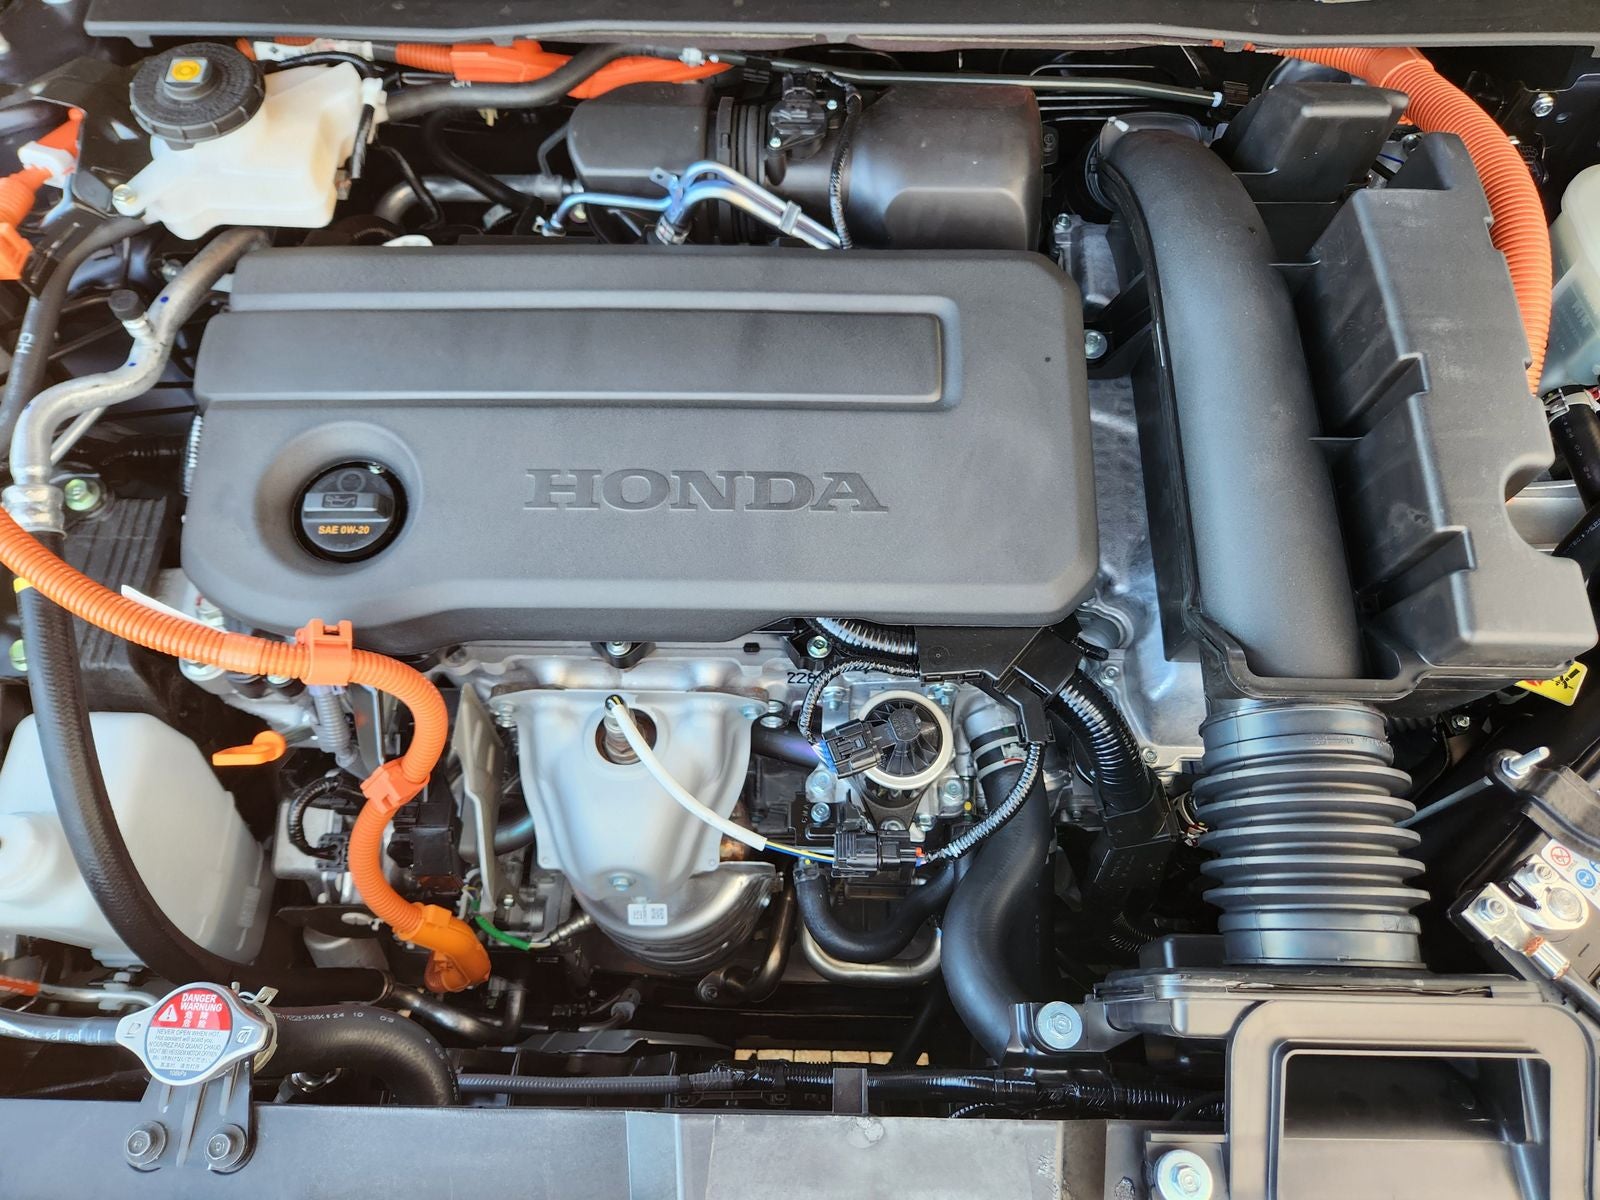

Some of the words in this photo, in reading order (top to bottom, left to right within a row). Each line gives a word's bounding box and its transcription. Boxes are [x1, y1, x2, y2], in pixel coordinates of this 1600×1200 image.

[523, 468, 889, 514] HONDA
[318, 525, 339, 535] SAE
[340, 525, 370, 535] 0W-20
[182, 993, 218, 1002] DANGER
[180, 1002, 223, 1012] WARNUNG
